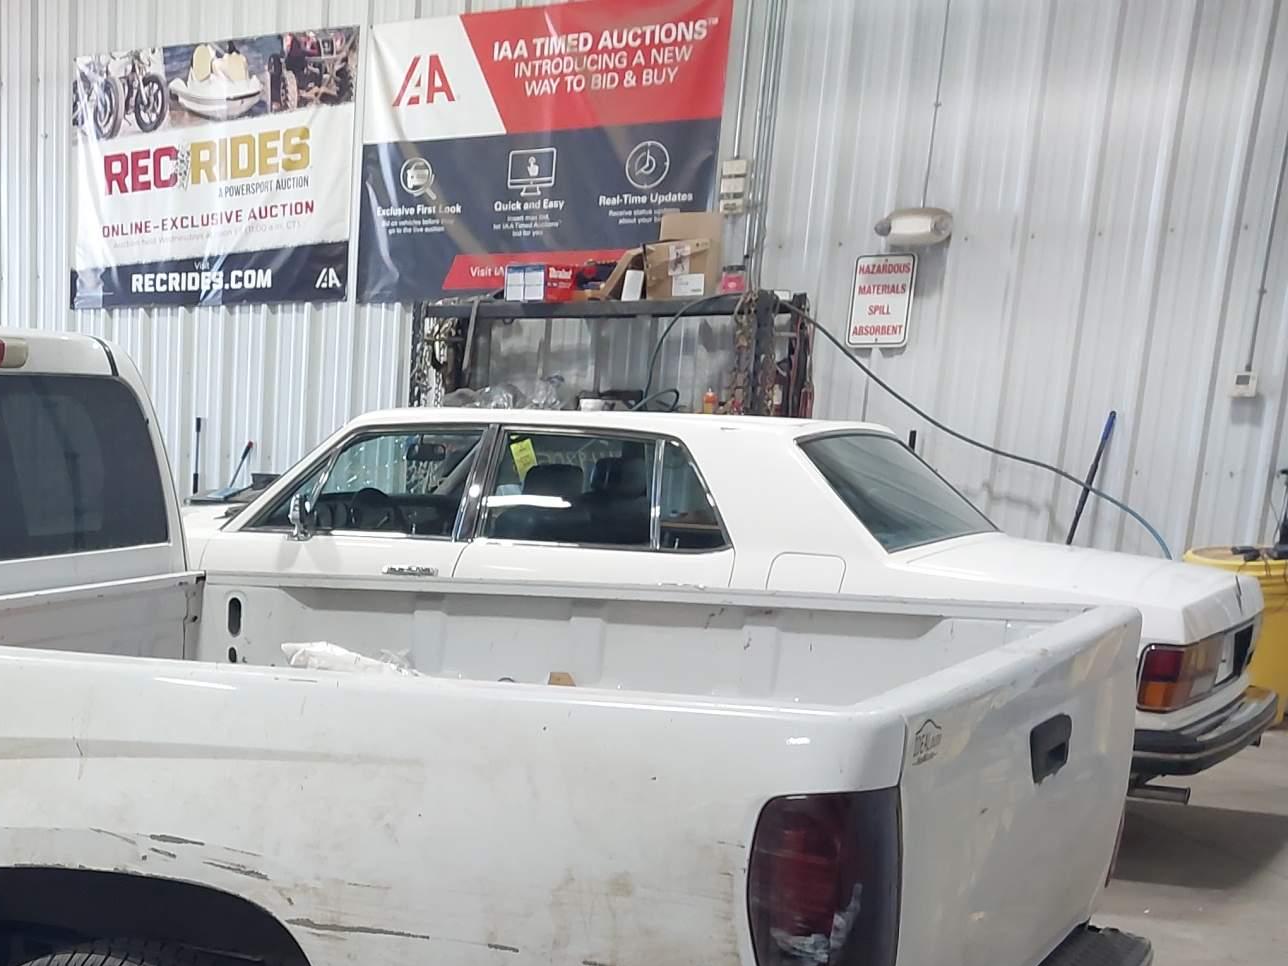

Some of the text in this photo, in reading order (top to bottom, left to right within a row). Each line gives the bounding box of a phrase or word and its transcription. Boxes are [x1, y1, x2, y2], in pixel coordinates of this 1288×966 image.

[493, 40, 528, 61] IAA
[533, 31, 593, 57] TIMED
[514, 45, 693, 79] INTRODUCING A NEW
[524, 66, 679, 97] WAY TO BID & BUY
[104, 127, 310, 195] REC RIDES
[224, 179, 273, 198] POWERSPORT
[275, 175, 310, 191] AUCTION
[494, 198, 565, 212] Quick and Easy
[599, 192, 694, 207] Real-Time Updates
[376, 203, 462, 217] Exclusive First Look
[102, 209, 243, 239] ONLINE-EXCLUSIVE
[248, 200, 315, 220] AUCTION
[470, 266, 492, 277] Visit
[859, 262, 911, 275] HAZARDOUS
[131, 269, 273, 293] RECRIDES.COM
[858, 283, 907, 295] MATERIALS
[868, 304, 891, 316] SPILL
[852, 325, 903, 336] ABSORBENT
